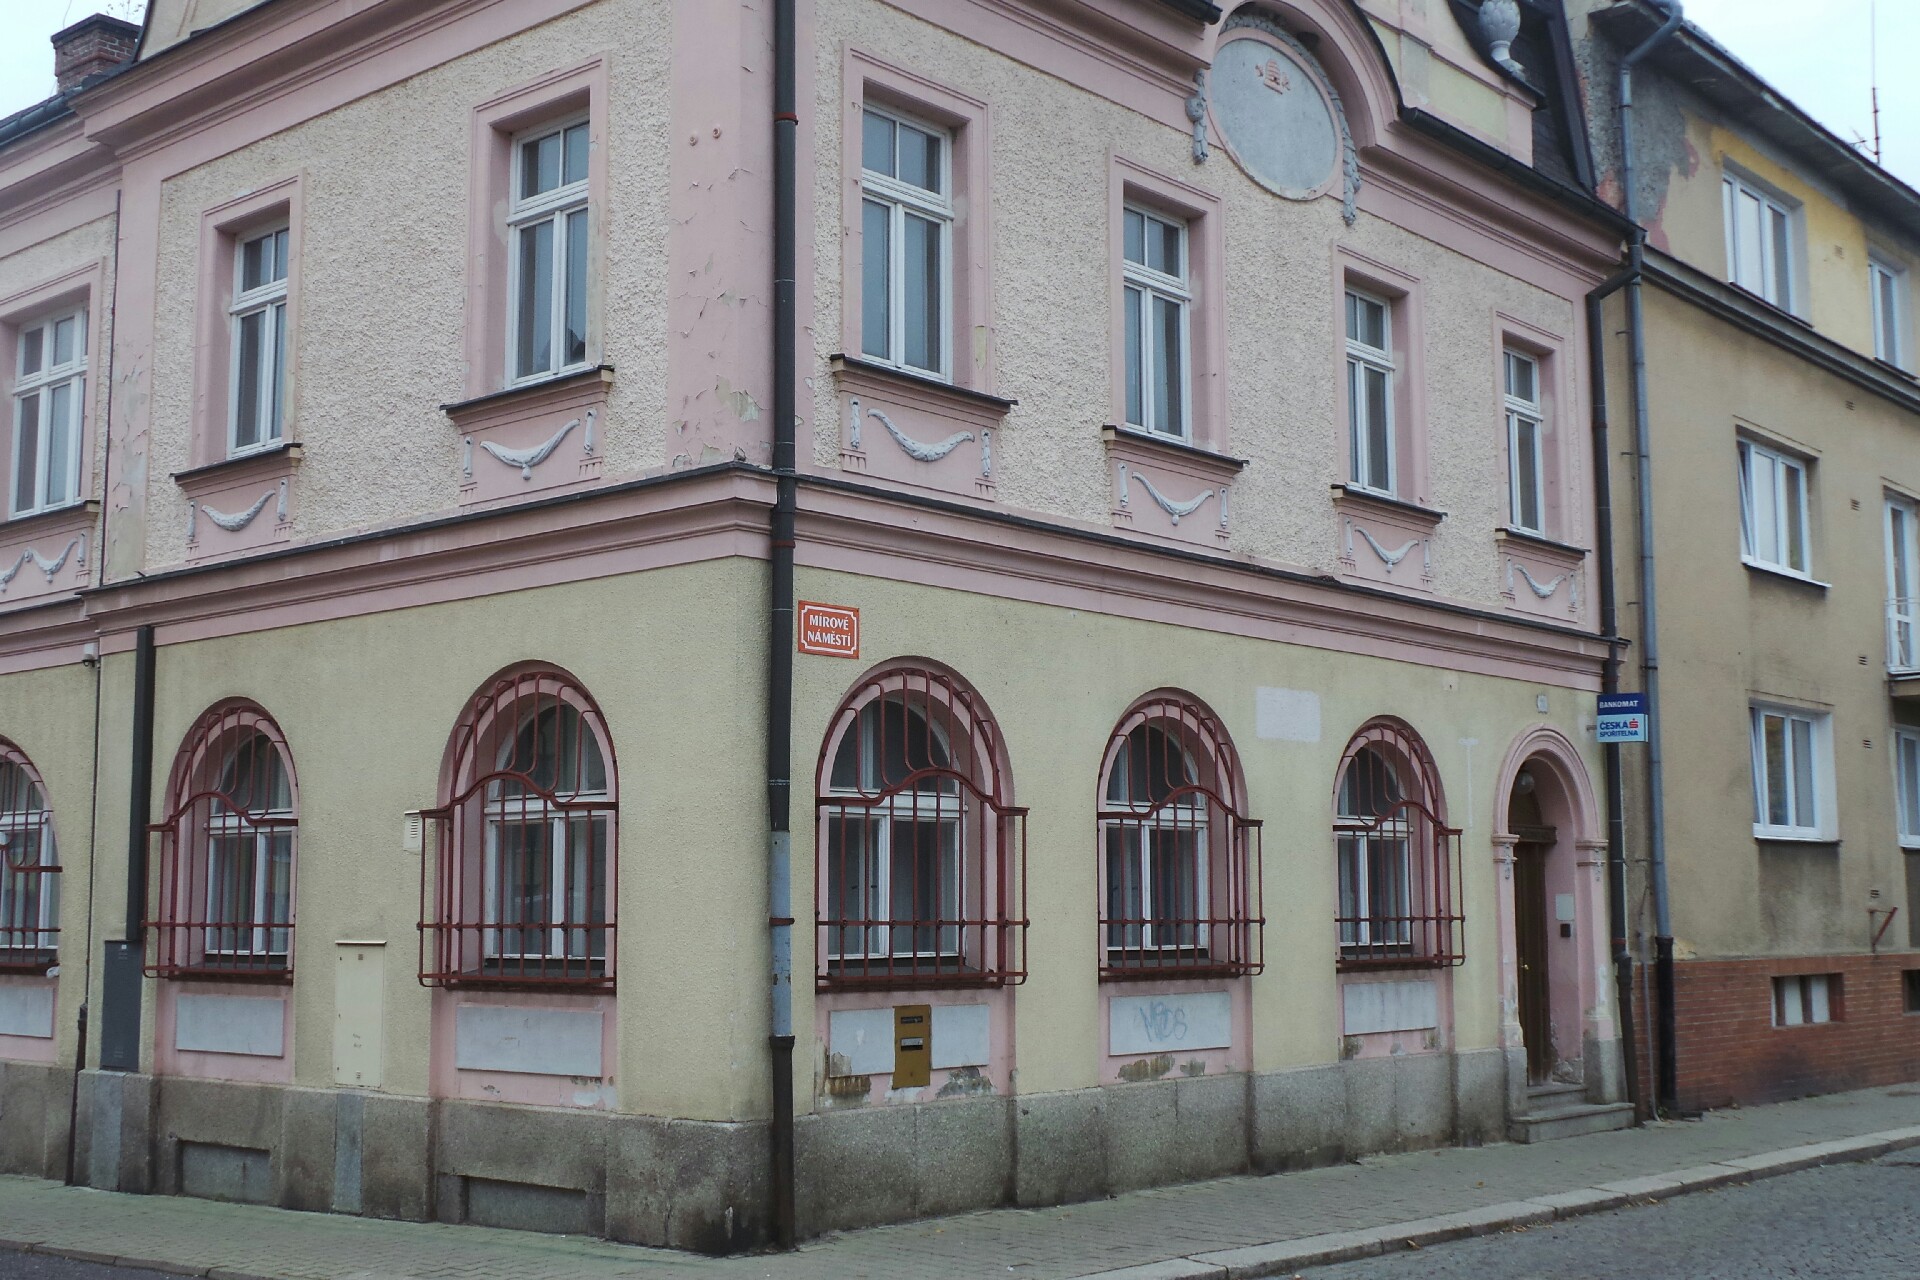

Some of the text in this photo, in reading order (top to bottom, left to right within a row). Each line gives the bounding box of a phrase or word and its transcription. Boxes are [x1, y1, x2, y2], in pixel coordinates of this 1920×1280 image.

[809, 612, 849, 631] MÍROVÉ
[807, 629, 851, 647] NÁMĚSTÍ
[1599, 700, 1639, 709] BANKOMAT
[1599, 720, 1629, 730] ČESKÁ
